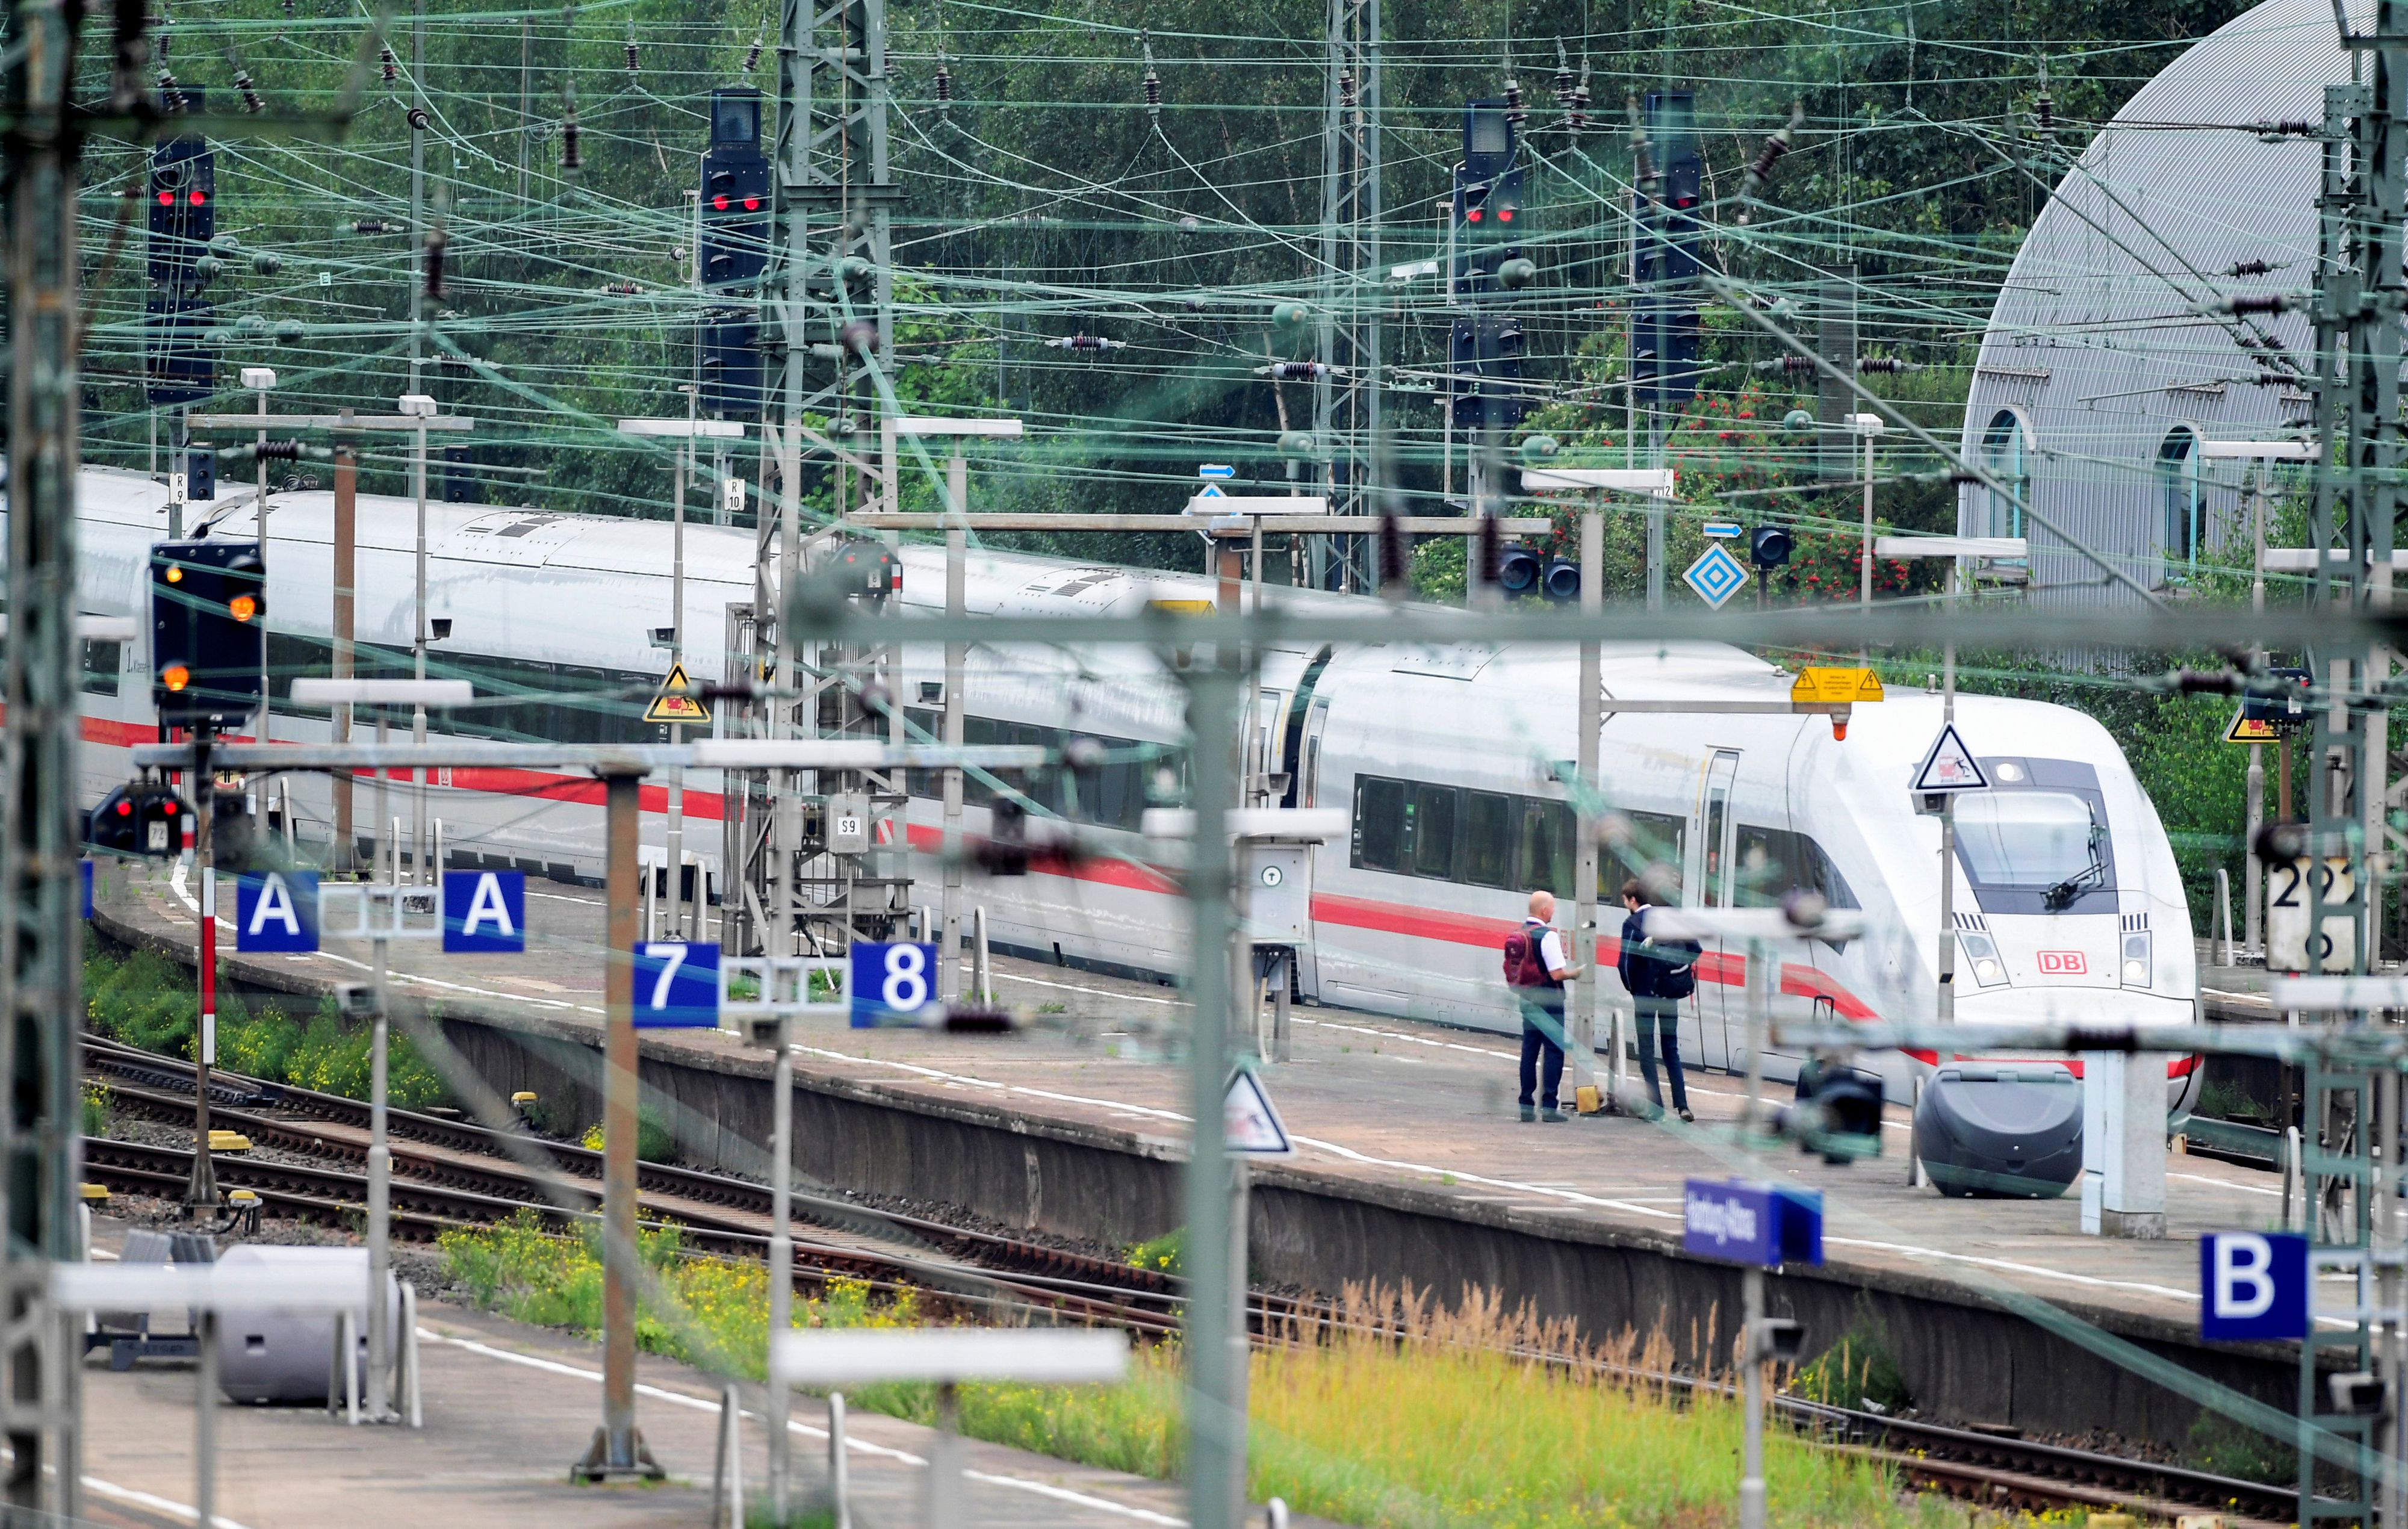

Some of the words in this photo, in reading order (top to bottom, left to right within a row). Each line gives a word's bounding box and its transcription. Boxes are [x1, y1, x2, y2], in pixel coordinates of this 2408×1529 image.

[177, 476, 183, 487] R
[177, 490, 183, 501] 9
[731, 482, 737, 493] R
[729, 496, 739, 508] 10
[248, 872, 300, 935] A
[462, 872, 515, 936] A
[645, 943, 689, 1011] 7
[882, 943, 928, 1012] 8
[2043, 954, 2082, 970] DB
[2214, 1234, 2276, 1319] B
